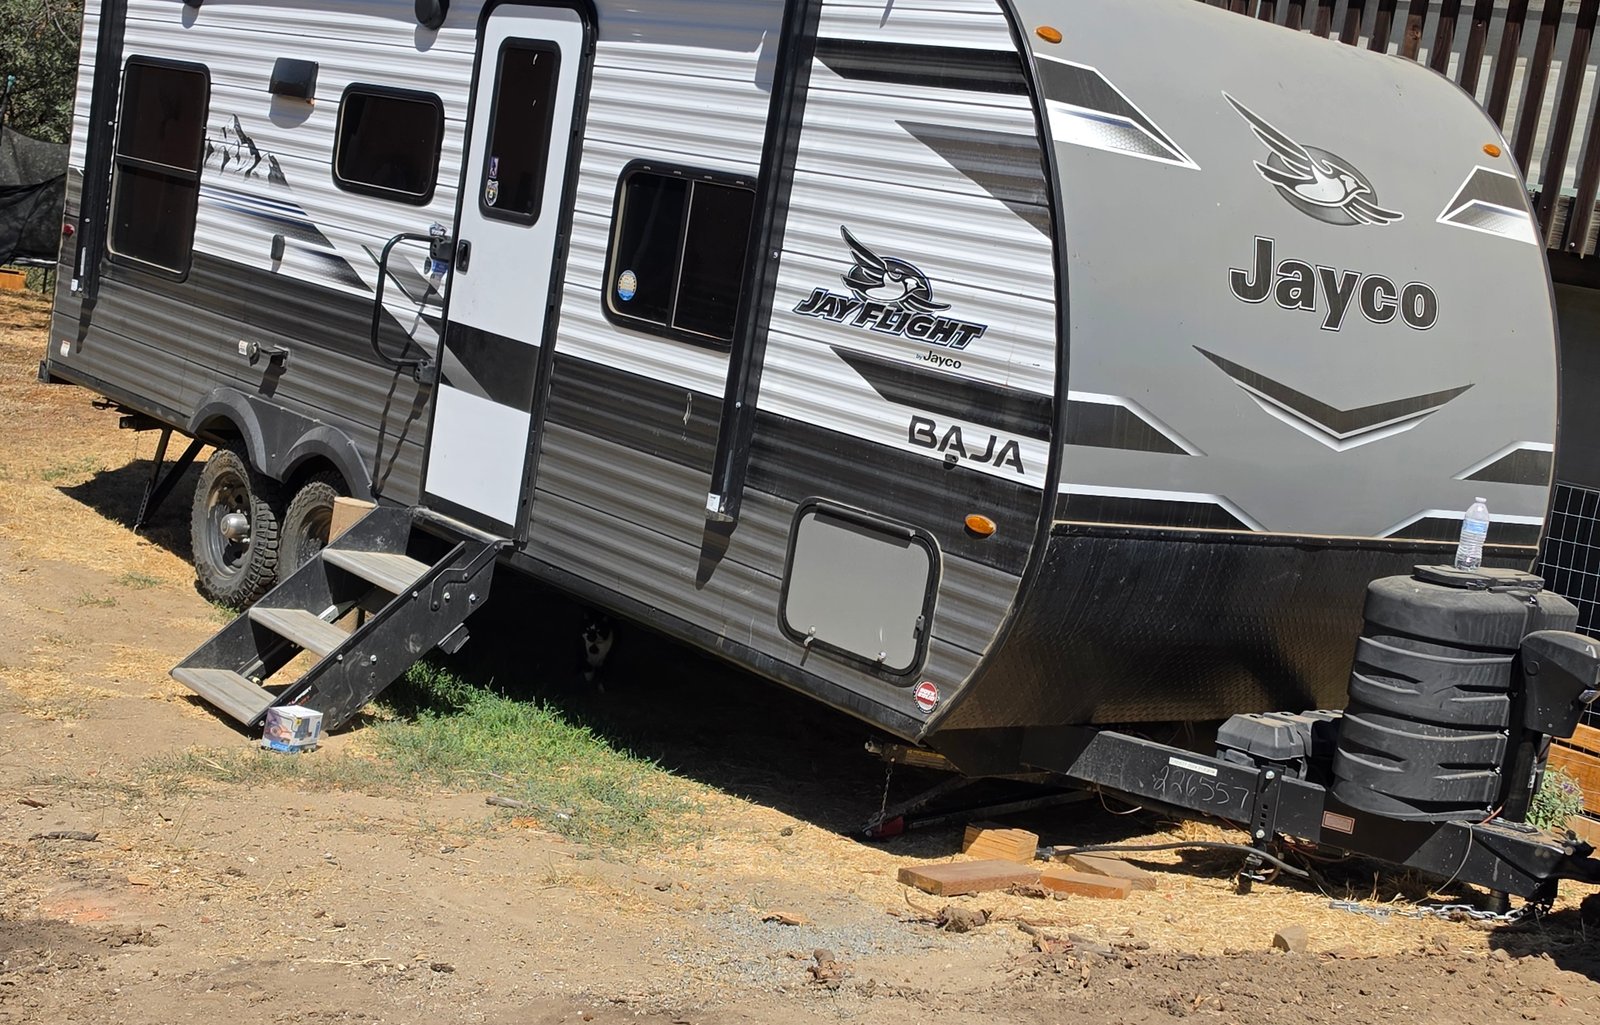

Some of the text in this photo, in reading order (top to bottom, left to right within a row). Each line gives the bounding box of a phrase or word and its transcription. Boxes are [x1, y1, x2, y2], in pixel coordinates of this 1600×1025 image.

[1229, 235, 1439, 332] Jayco
[792, 287, 988, 350] JAY FLIGHT
[923, 350, 962, 369] Jayco
[908, 415, 1025, 475] BAJA
